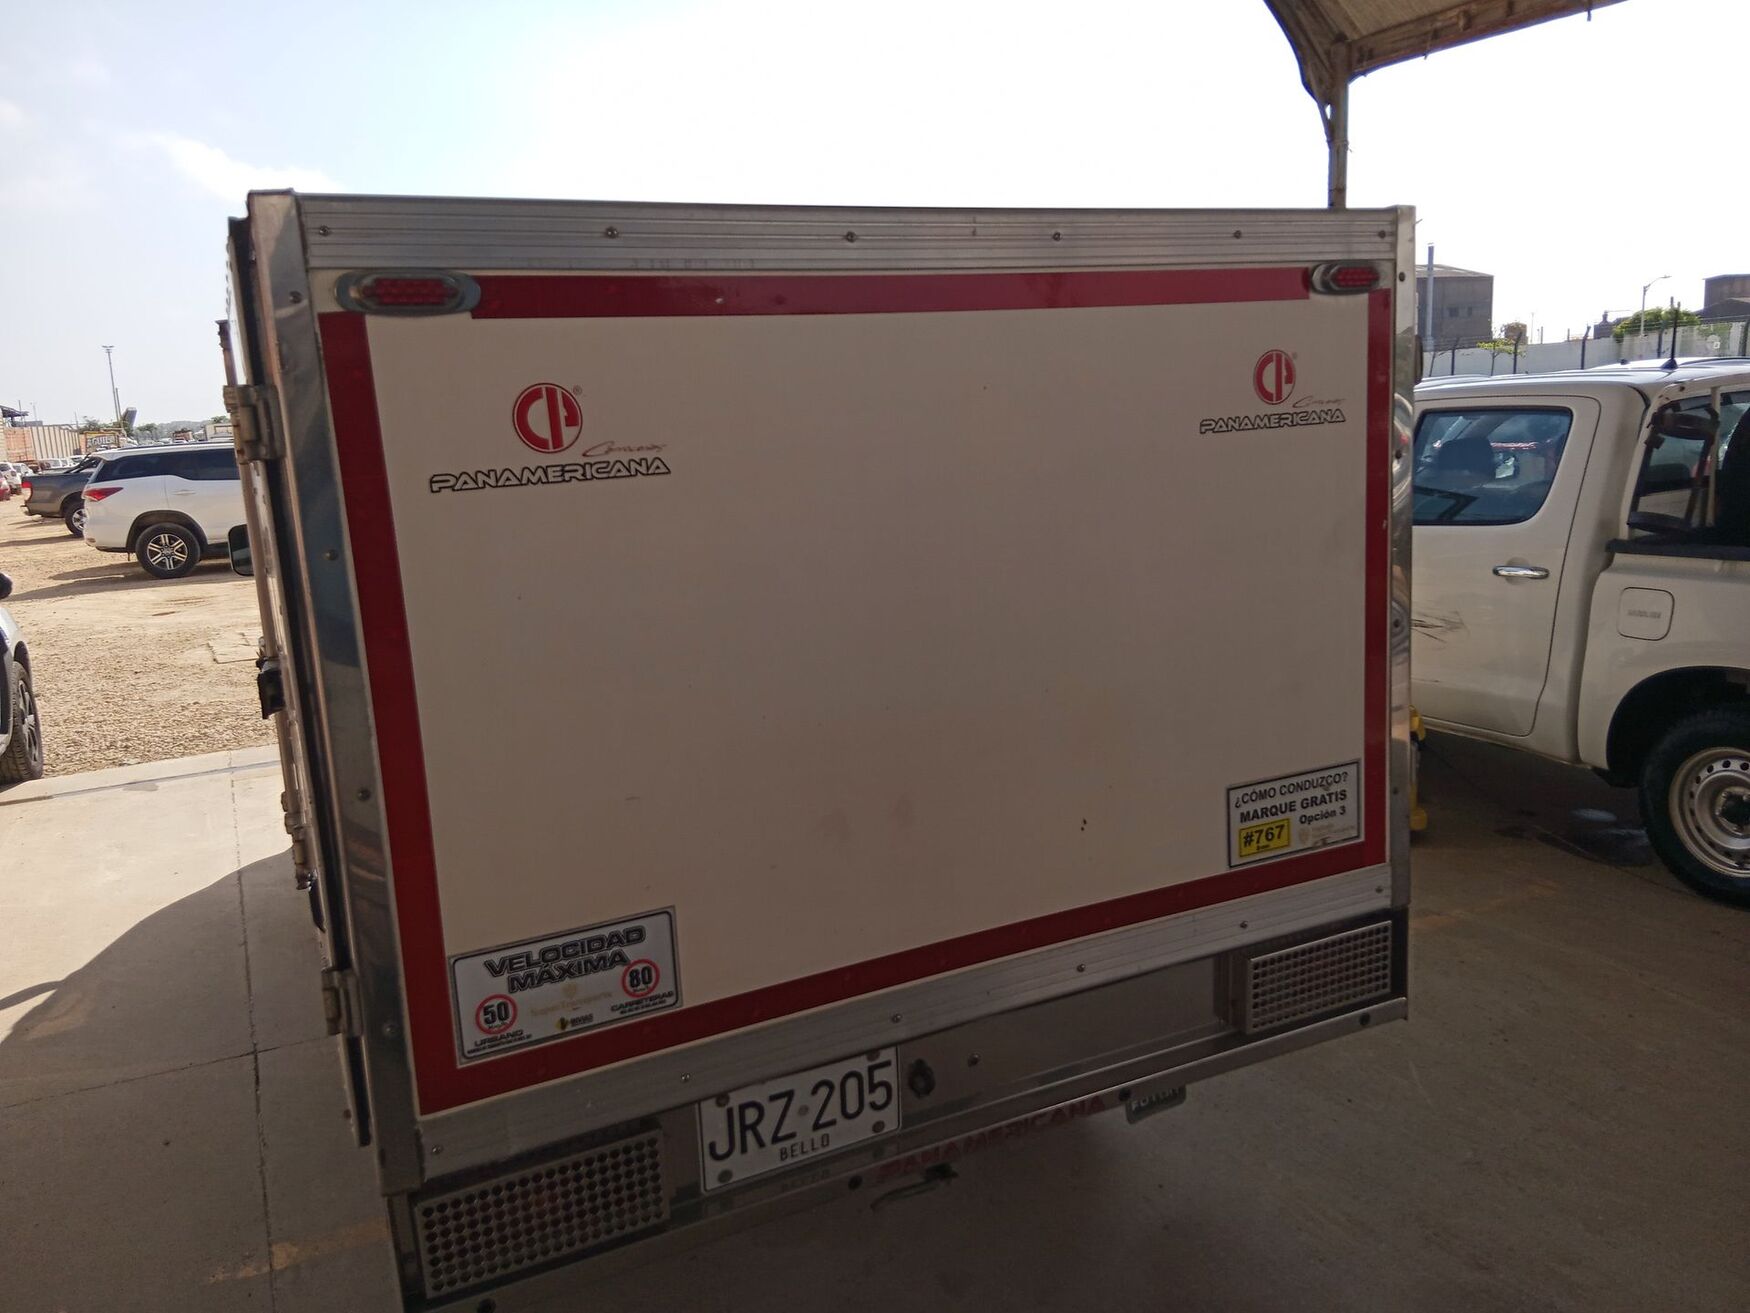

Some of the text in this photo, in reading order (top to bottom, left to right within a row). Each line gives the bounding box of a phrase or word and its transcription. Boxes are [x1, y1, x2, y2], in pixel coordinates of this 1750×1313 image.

[1200, 408, 1346, 434] PANAMERICANA
[430, 456, 671, 493] PANAMERICANA
[1279, 771, 1349, 796] CONDUZCO?
[1240, 789, 1347, 823] MARQUE GRATIS
[1339, 805, 1346, 816] 3
[1243, 823, 1285, 848] #767
[484, 925, 647, 977] VELOCIDAD
[507, 948, 631, 993] MÁXIMA
[627, 965, 653, 989] 80
[482, 1001, 510, 1025] 50
[708, 1059, 893, 1162] JRZ 205
[779, 1133, 830, 1162] BELLO
